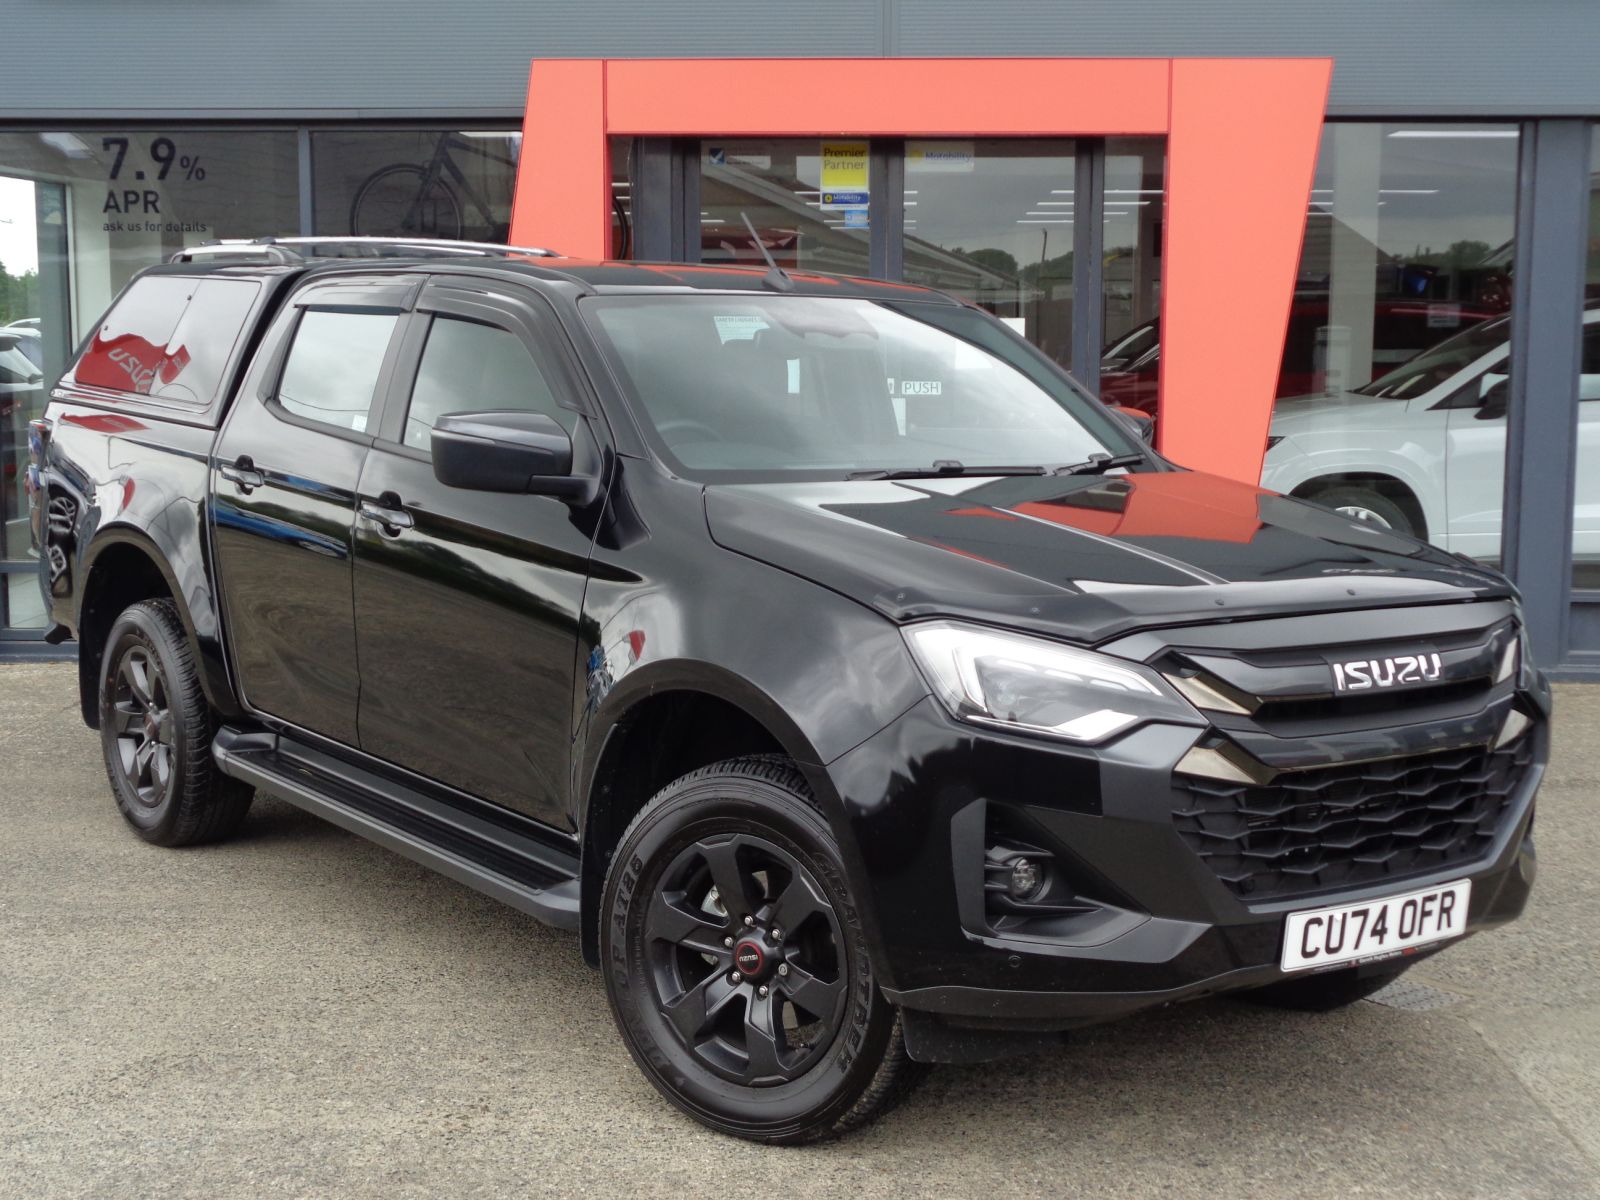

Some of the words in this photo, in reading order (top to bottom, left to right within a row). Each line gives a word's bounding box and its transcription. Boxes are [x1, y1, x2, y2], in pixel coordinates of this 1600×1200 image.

[102, 137, 206, 181] 7.9%
[824, 147, 865, 157] Premier
[824, 159, 865, 170] Partner
[102, 189, 160, 214] APR
[103, 221, 124, 233] ask
[127, 223, 142, 233] us
[145, 221, 162, 233] for
[165, 221, 208, 233] details
[904, 382, 939, 394] PUSH
[1333, 653, 1442, 691] ISUZU
[1300, 904, 1389, 959] CU74
[1398, 890, 1456, 940] OFR
